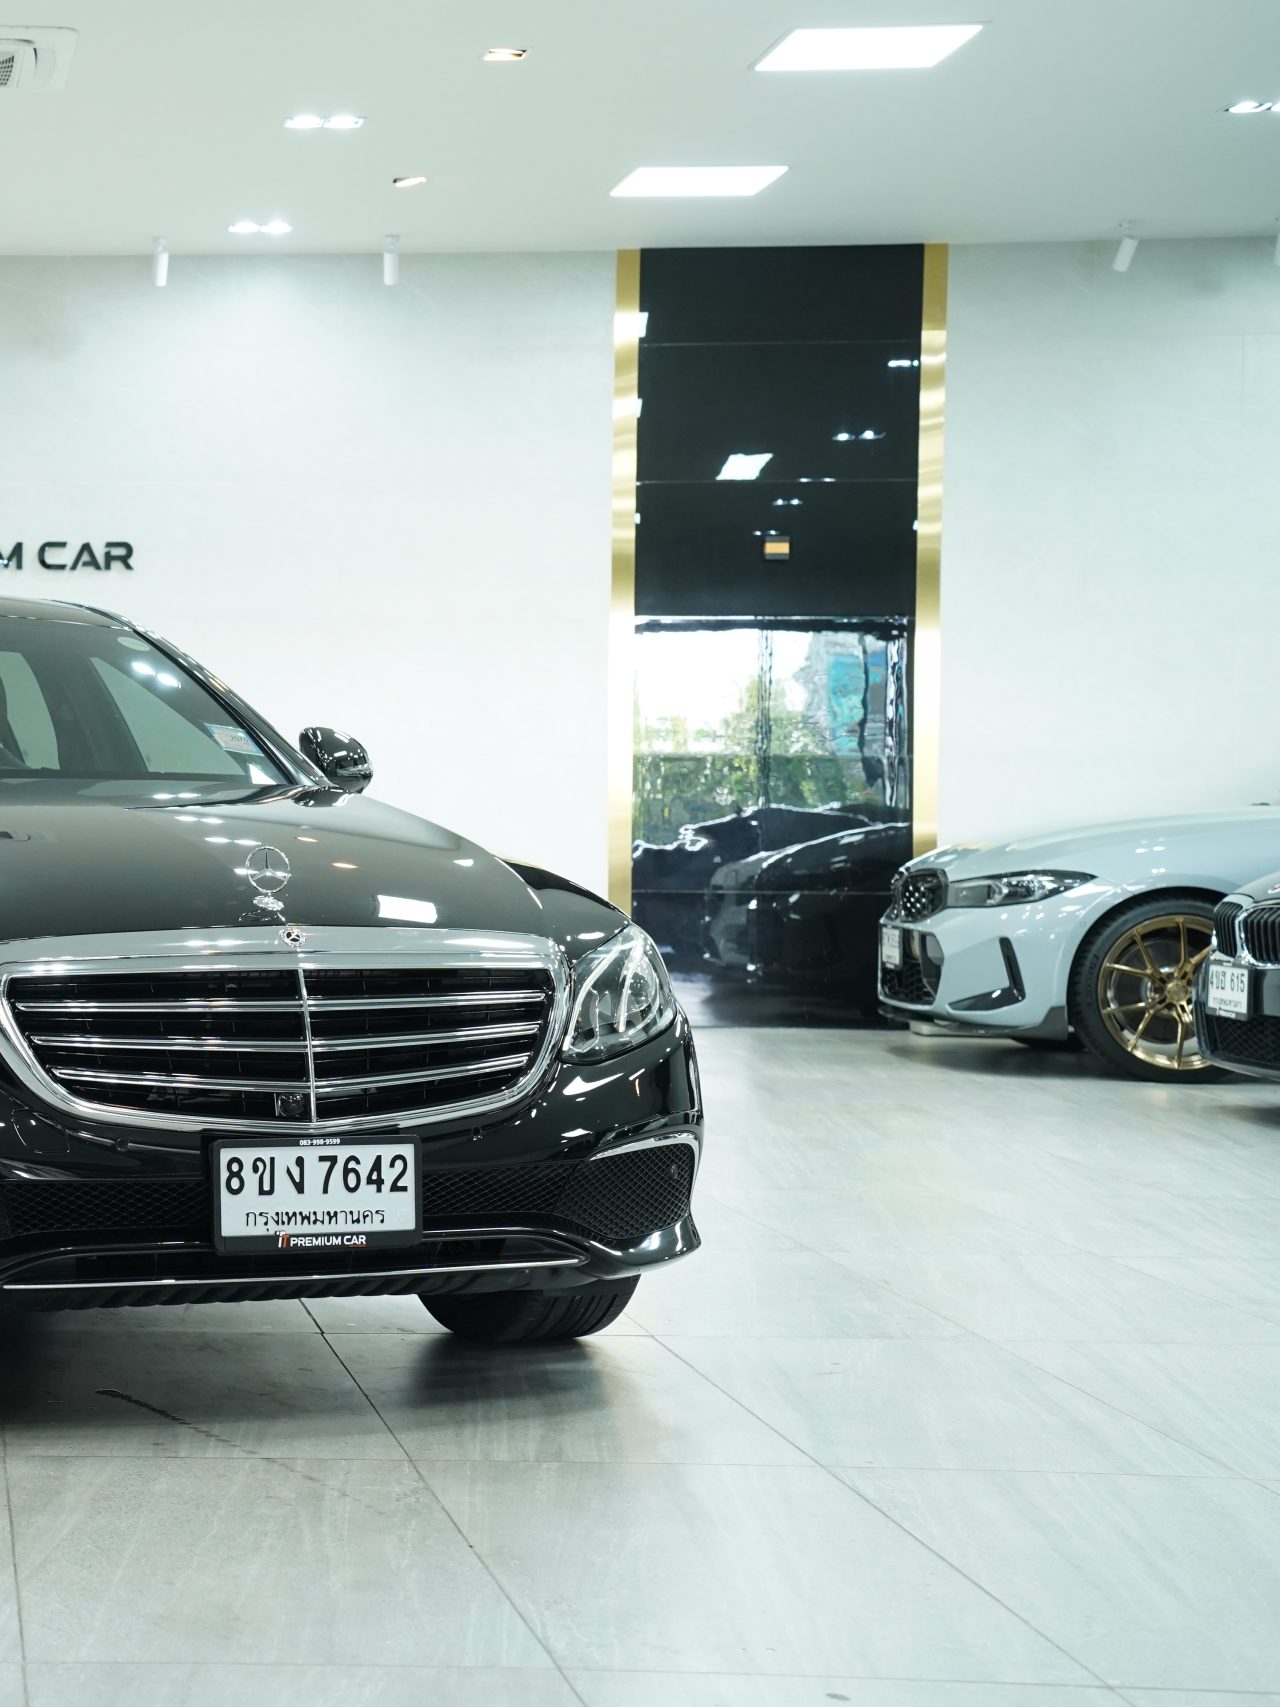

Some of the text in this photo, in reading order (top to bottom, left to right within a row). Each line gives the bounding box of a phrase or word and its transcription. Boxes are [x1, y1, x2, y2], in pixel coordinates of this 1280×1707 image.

[37, 541, 135, 570] CAR
[1230, 972, 1246, 993] 615
[318, 1153, 409, 1195] 7642
[245, 1208, 386, 1231] กรุงเทพมหานคร
[290, 1235, 342, 1247] PREMIUM
[343, 1234, 367, 1245] CAR
